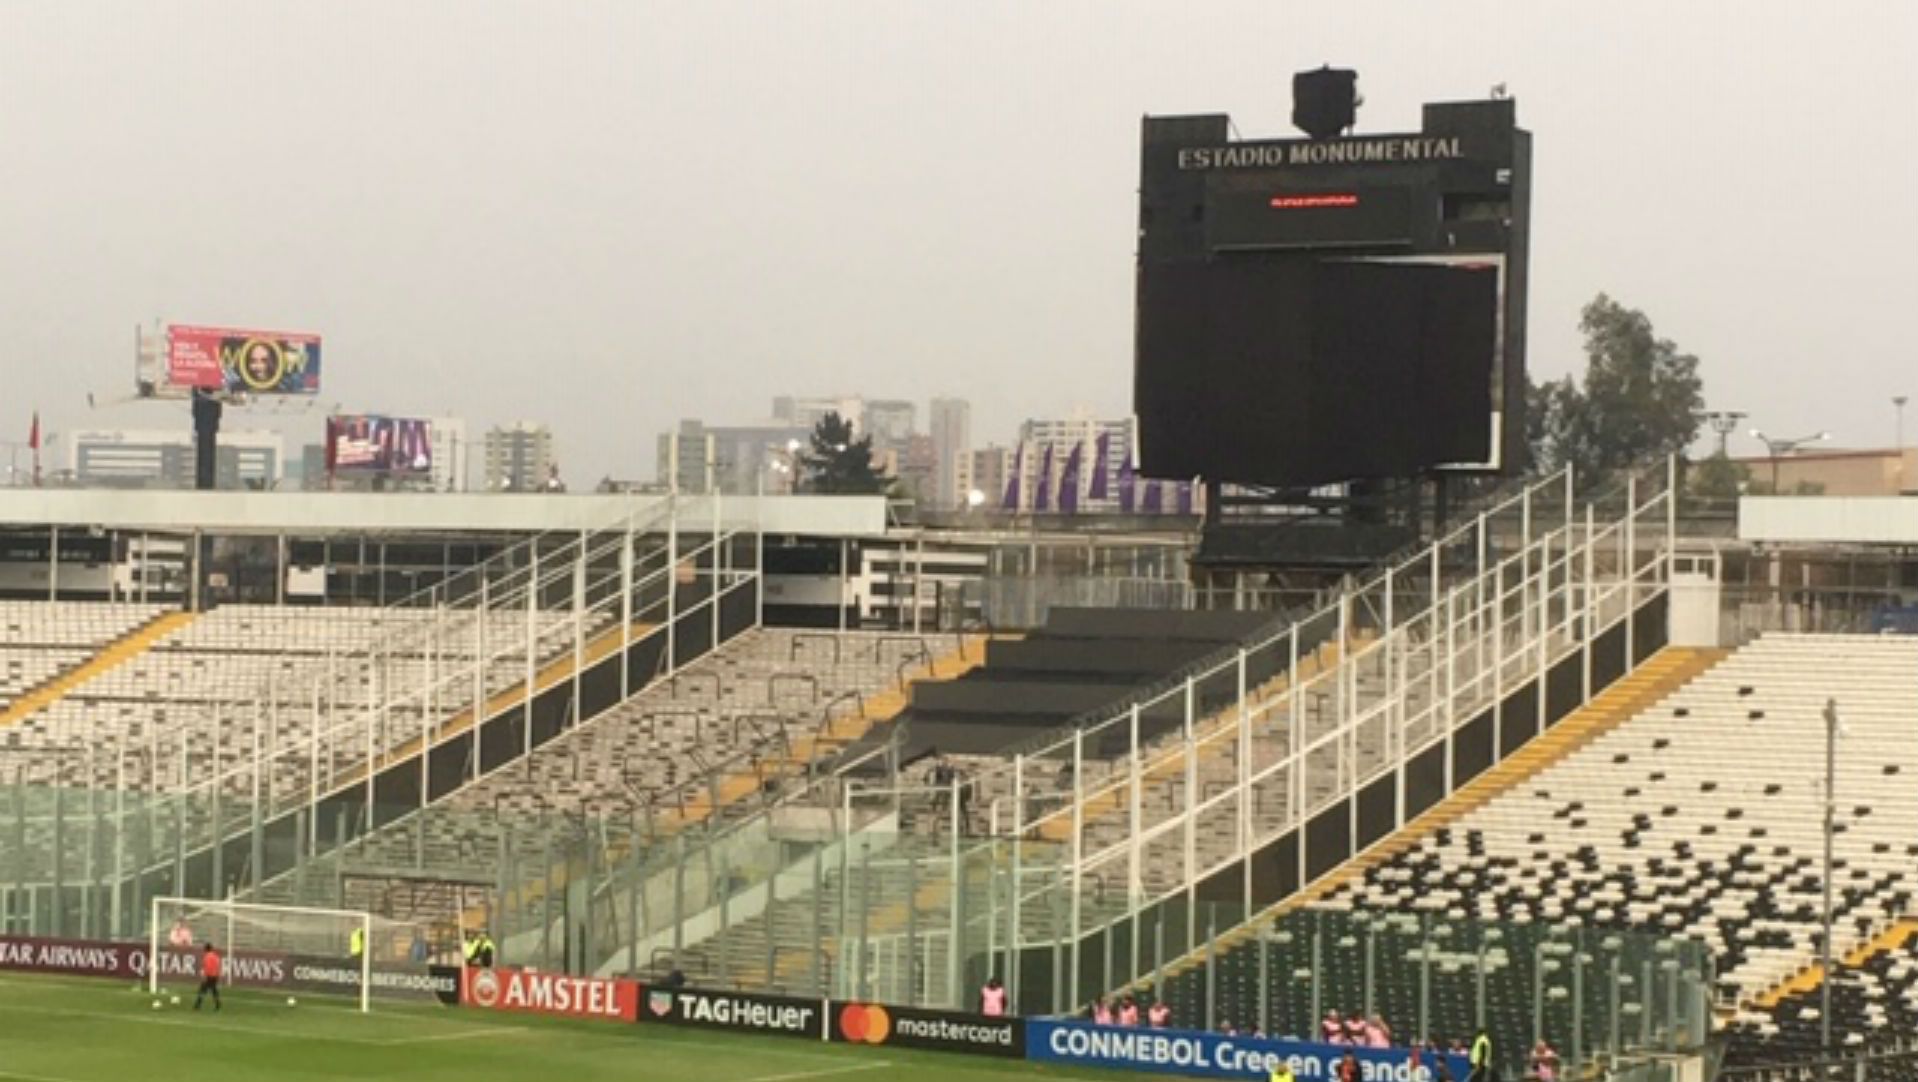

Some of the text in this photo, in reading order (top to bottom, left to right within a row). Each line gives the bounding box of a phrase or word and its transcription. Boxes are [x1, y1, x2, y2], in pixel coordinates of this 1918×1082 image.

[1178, 137, 1465, 170] ESTADIO MONUMENTAL
[37, 944, 119, 972] AIRWAYS
[128, 950, 196, 977] QTAR
[504, 973, 622, 1016] AMSTEL
[897, 1017, 1013, 1046] mastercard
[1050, 1027, 1432, 1082] CONMEBOL Cree en gande
